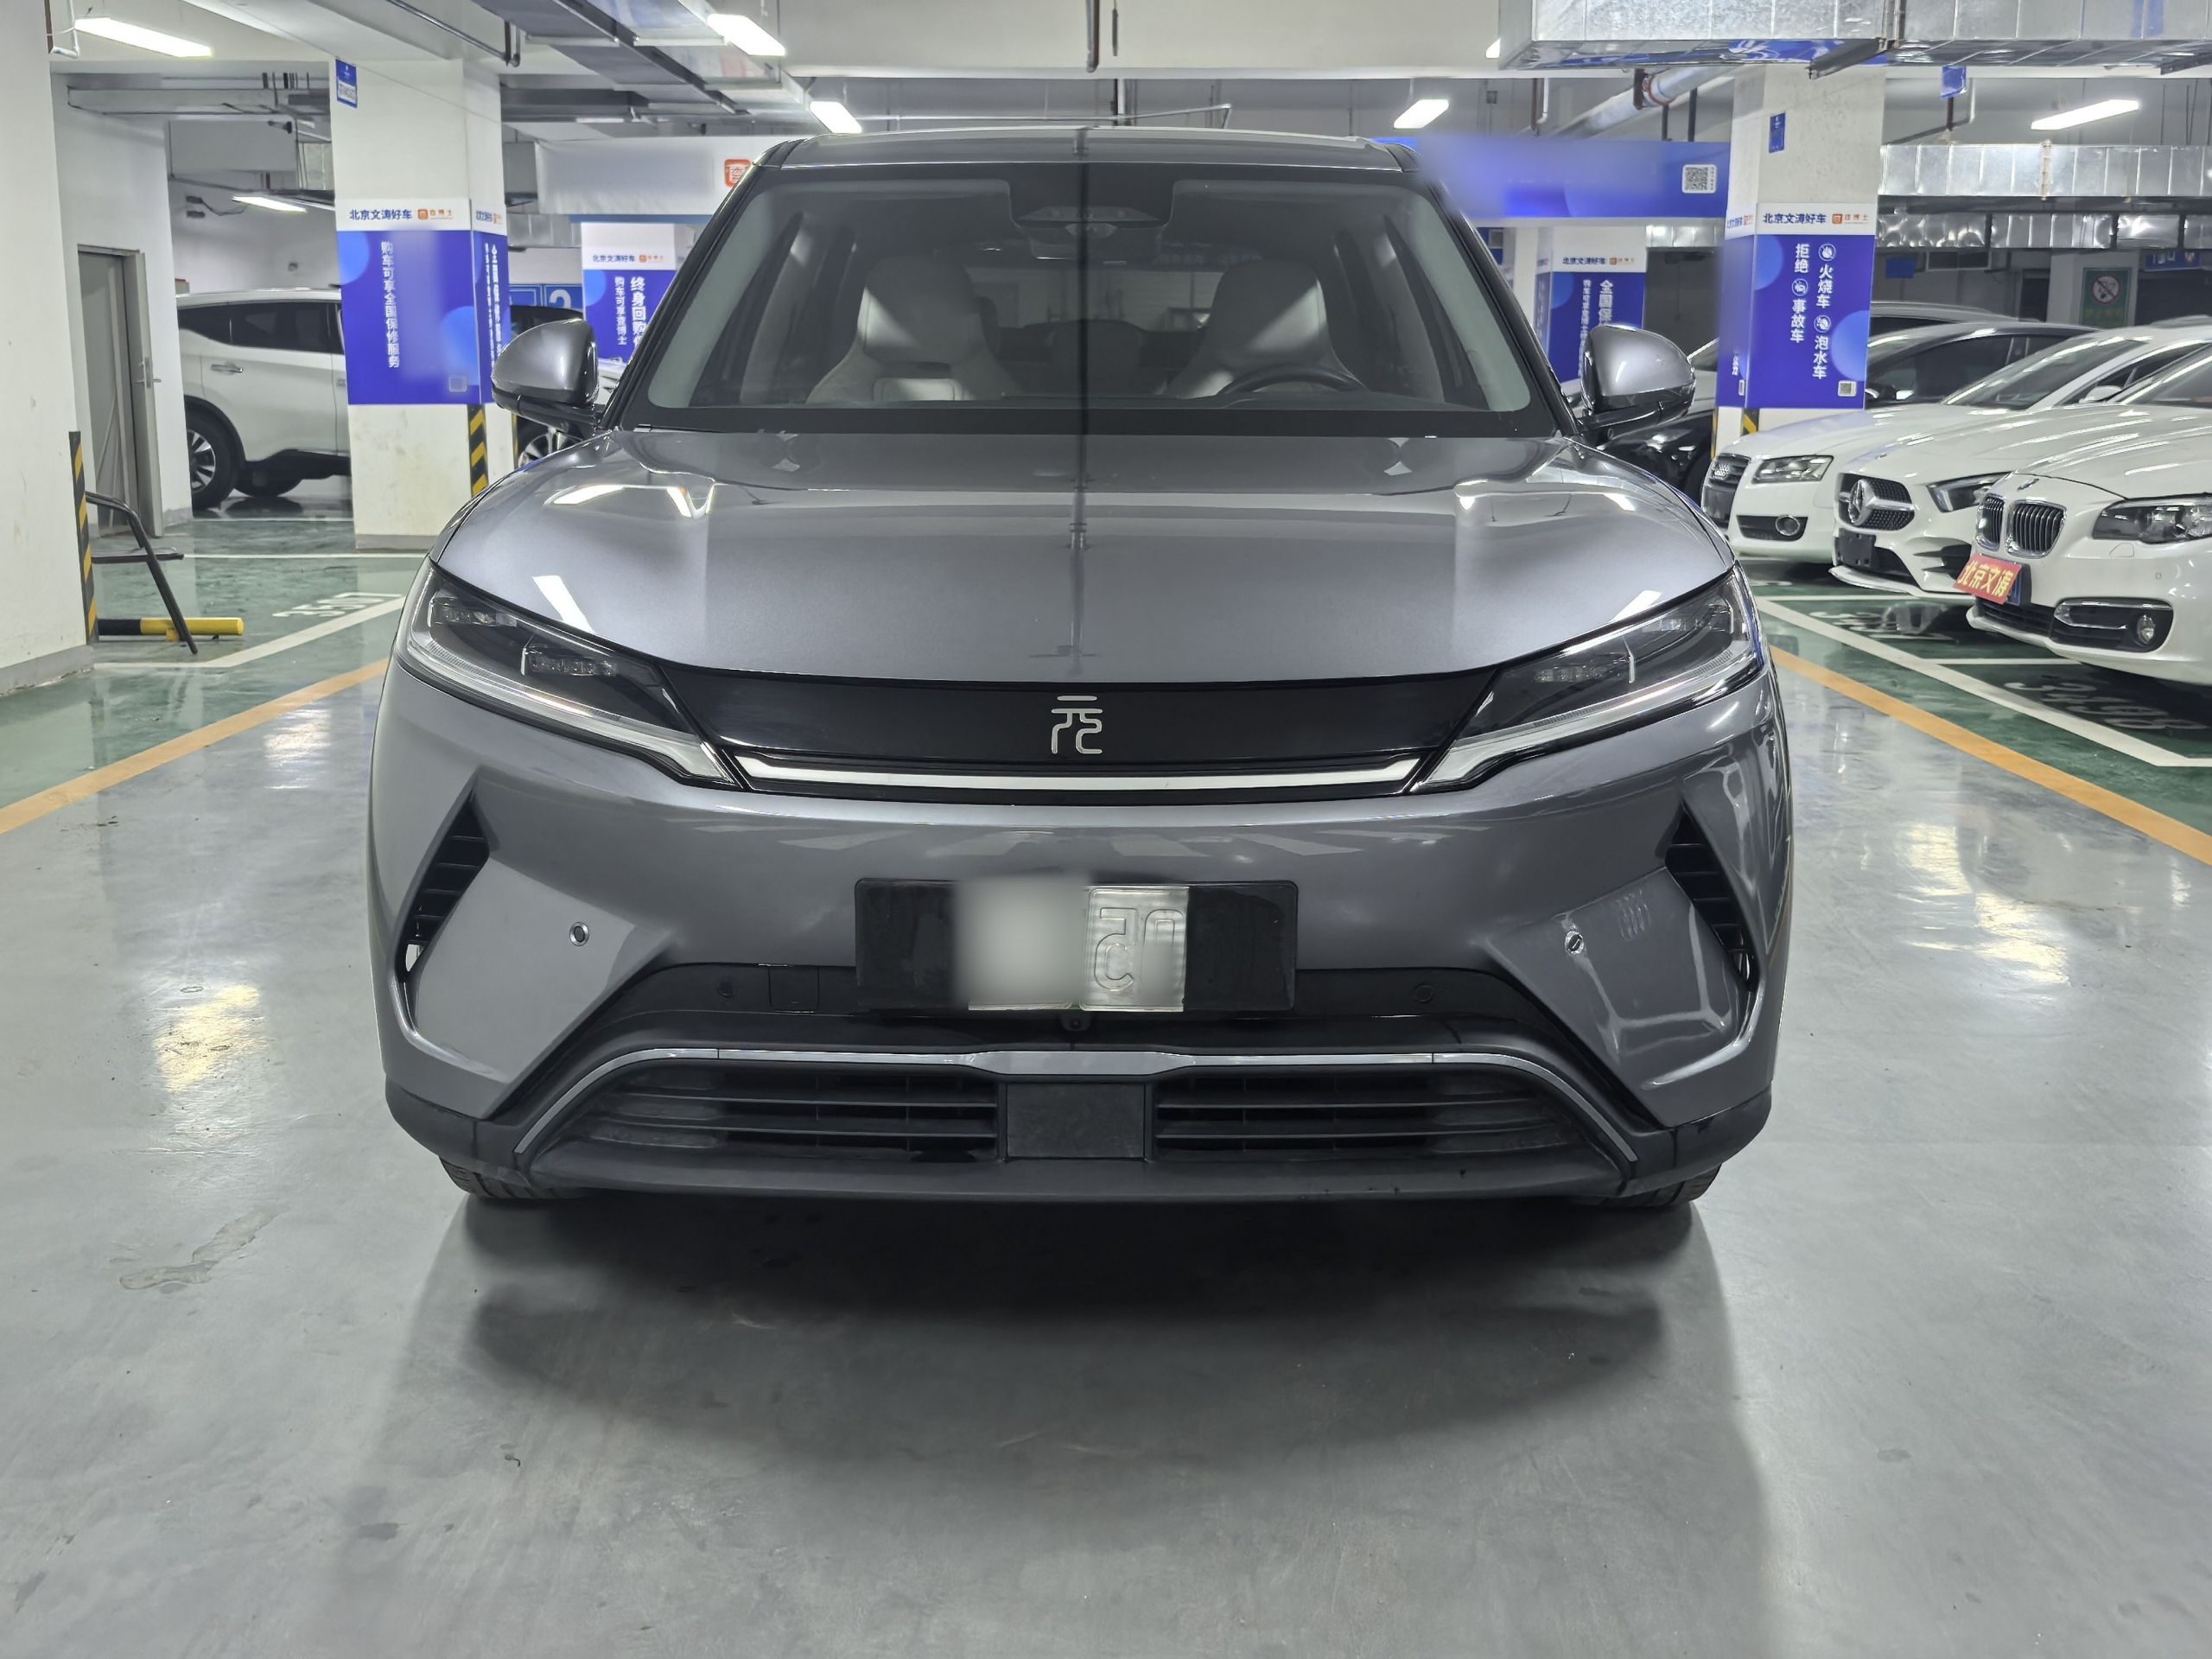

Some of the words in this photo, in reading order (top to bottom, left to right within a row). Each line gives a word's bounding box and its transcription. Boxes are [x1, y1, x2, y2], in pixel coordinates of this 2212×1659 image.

[349, 208, 412, 221] 北京文涛好车
[1763, 213, 1827, 225] 北京文涛好车
[1794, 243, 1810, 274] 拒绝
[381, 241, 400, 368] 购车可享全国保修服务
[1815, 264, 1833, 308] 火烧车
[1789, 299, 1807, 343] 事故车
[1812, 335, 1829, 379] 泡水车
[1957, 560, 2014, 598] 北京文涛
[1051, 695, 1103, 754] 元
